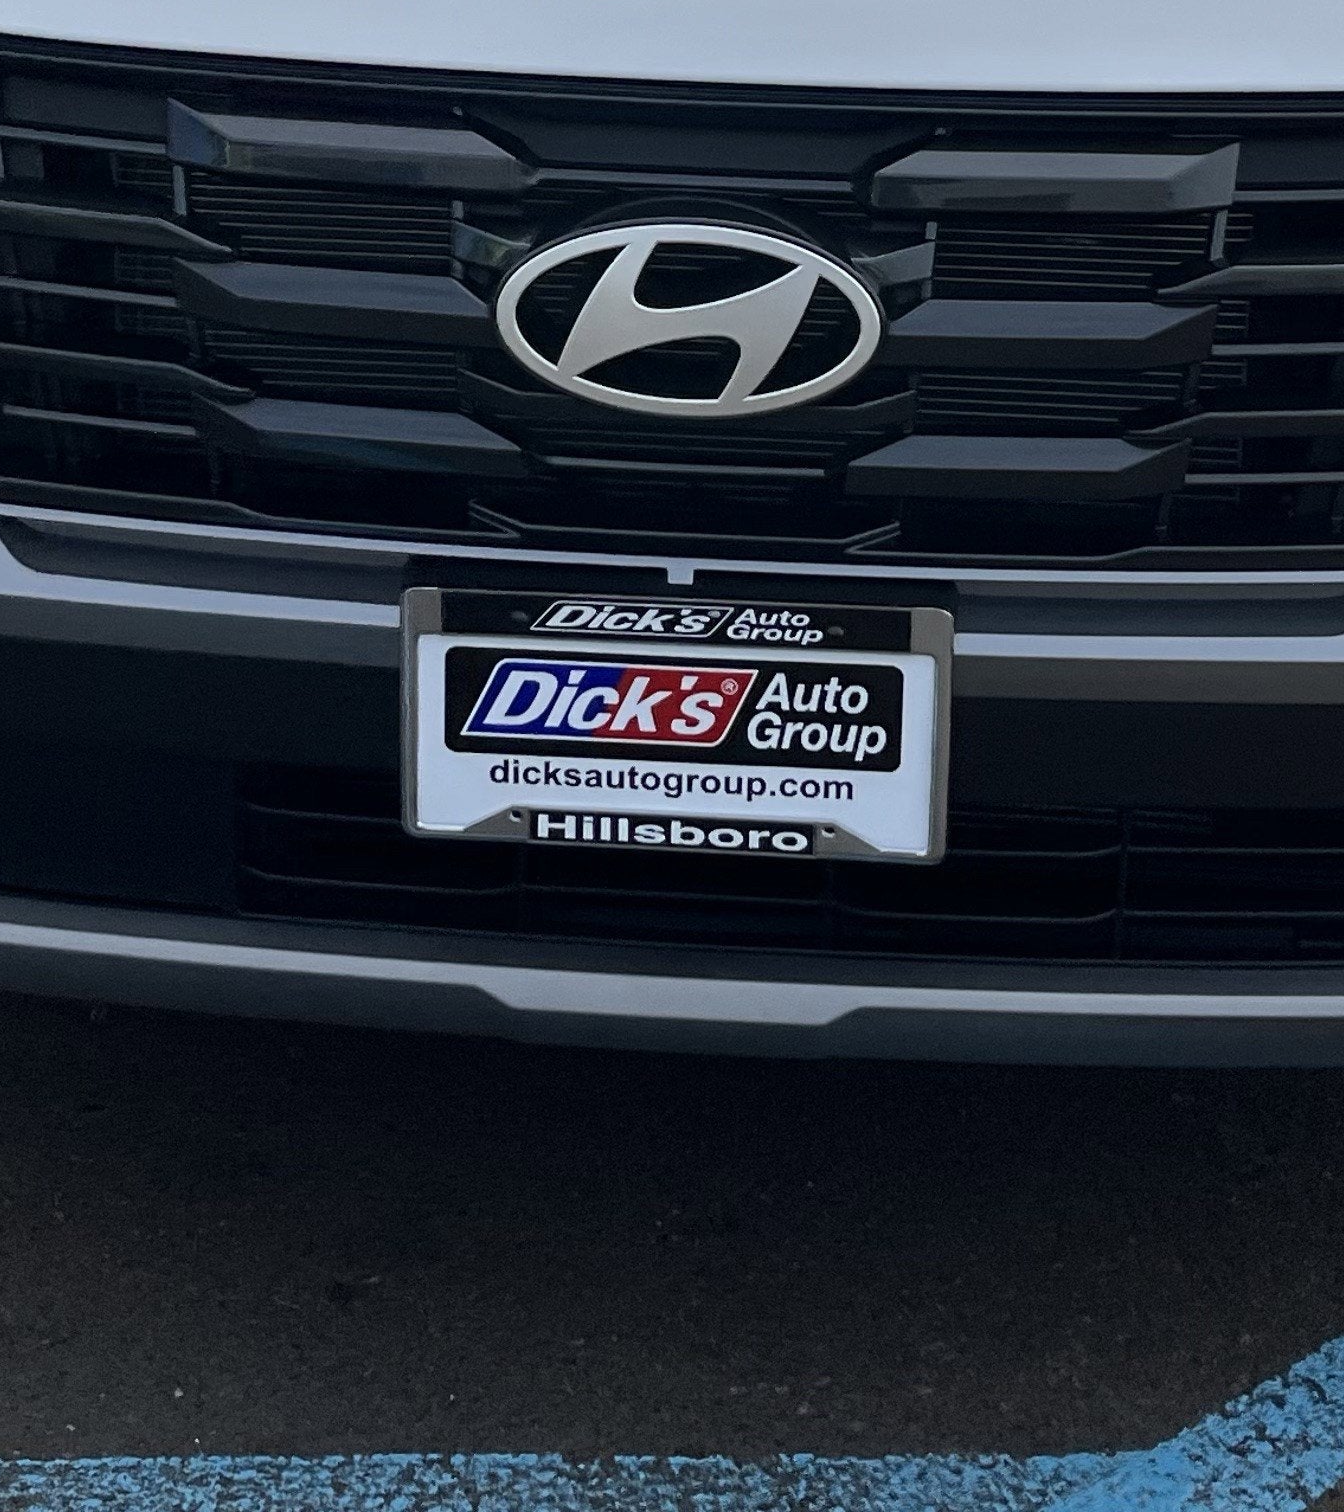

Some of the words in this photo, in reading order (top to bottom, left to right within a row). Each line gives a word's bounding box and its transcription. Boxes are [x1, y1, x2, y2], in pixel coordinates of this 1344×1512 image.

[545, 604, 711, 634] Dick's
[734, 608, 810, 628] Auto
[726, 623, 824, 645] Group
[483, 668, 724, 736] Dick's
[756, 672, 869, 715] Auto
[747, 710, 887, 762] Group
[489, 759, 854, 802] dicksautogroup.com
[537, 814, 808, 853] Hillsboro
